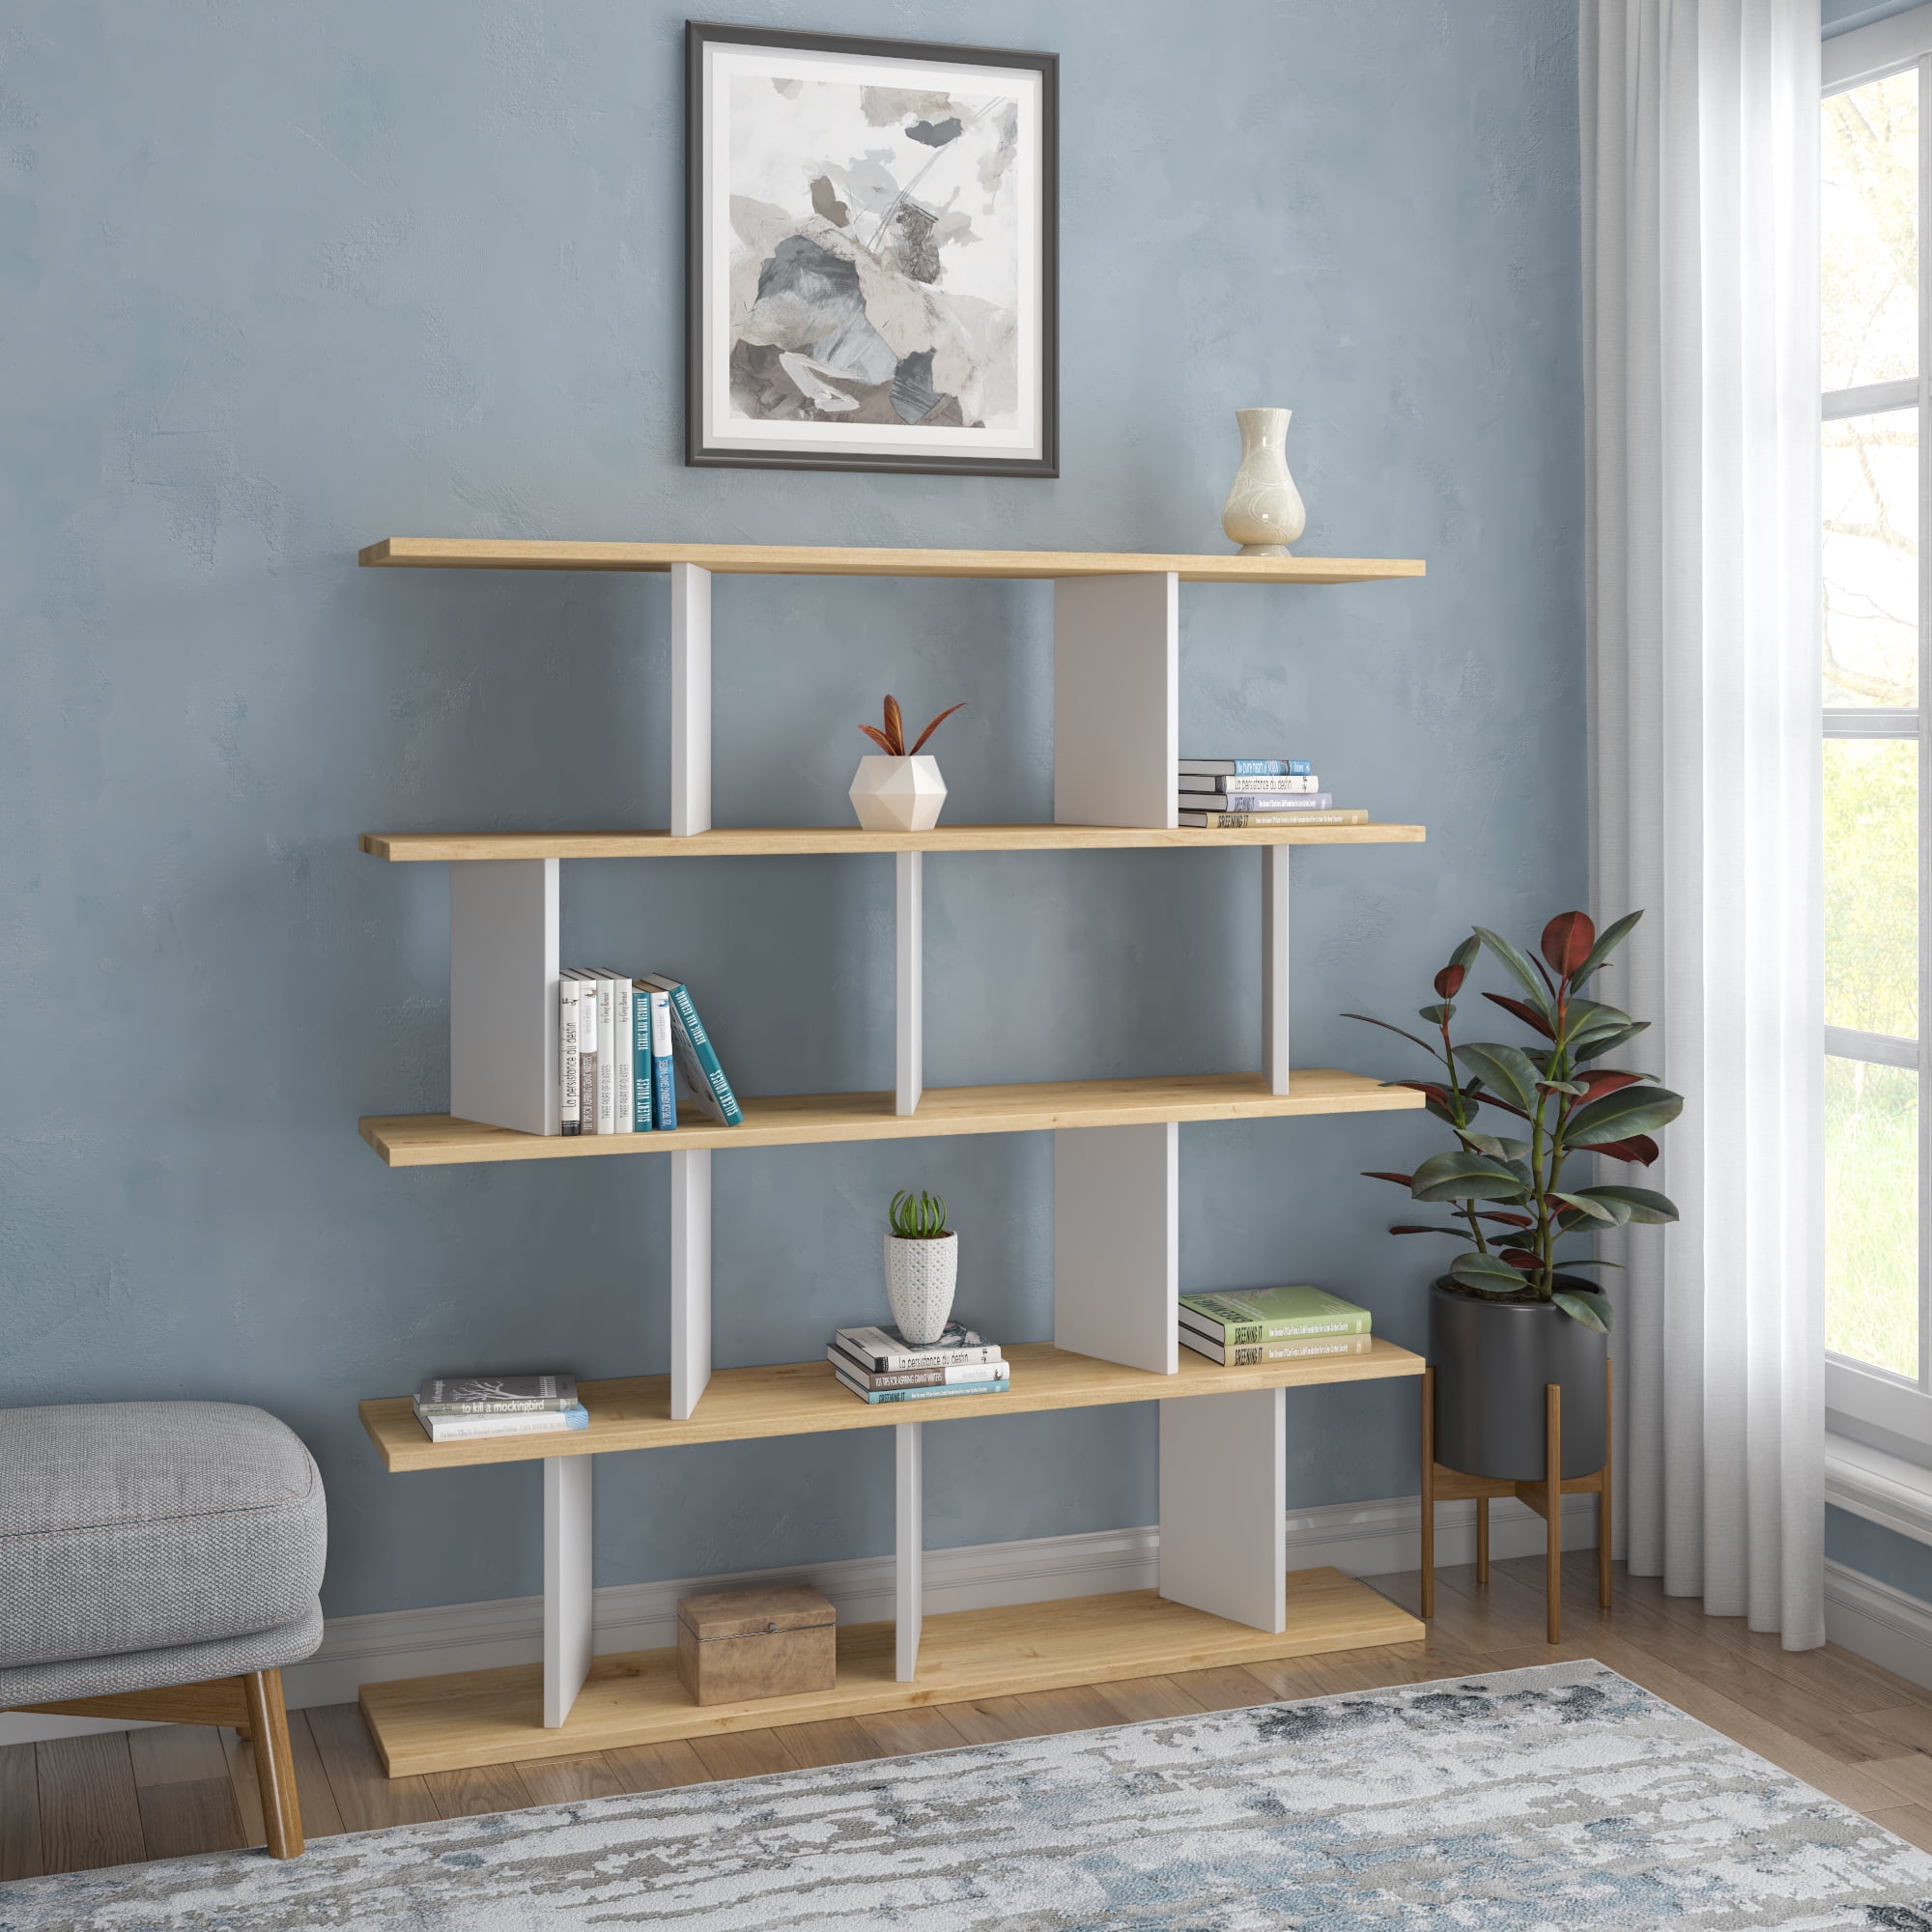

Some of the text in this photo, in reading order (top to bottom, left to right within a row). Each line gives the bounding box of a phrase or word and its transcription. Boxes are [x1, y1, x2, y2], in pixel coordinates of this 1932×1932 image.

[562, 1022, 577, 1043] destin
[562, 1058, 580, 1097] persistance
[638, 1078, 650, 1122] SILENT VOICES
[709, 1068, 739, 1117] SILENT VOICES
[562, 1099, 576, 1108] La
[899, 1351, 969, 1369] La persistance du destin
[463, 1405, 470, 1413] to
[473, 1402, 483, 1412] kill
[494, 1400, 544, 1413] mockingbird
